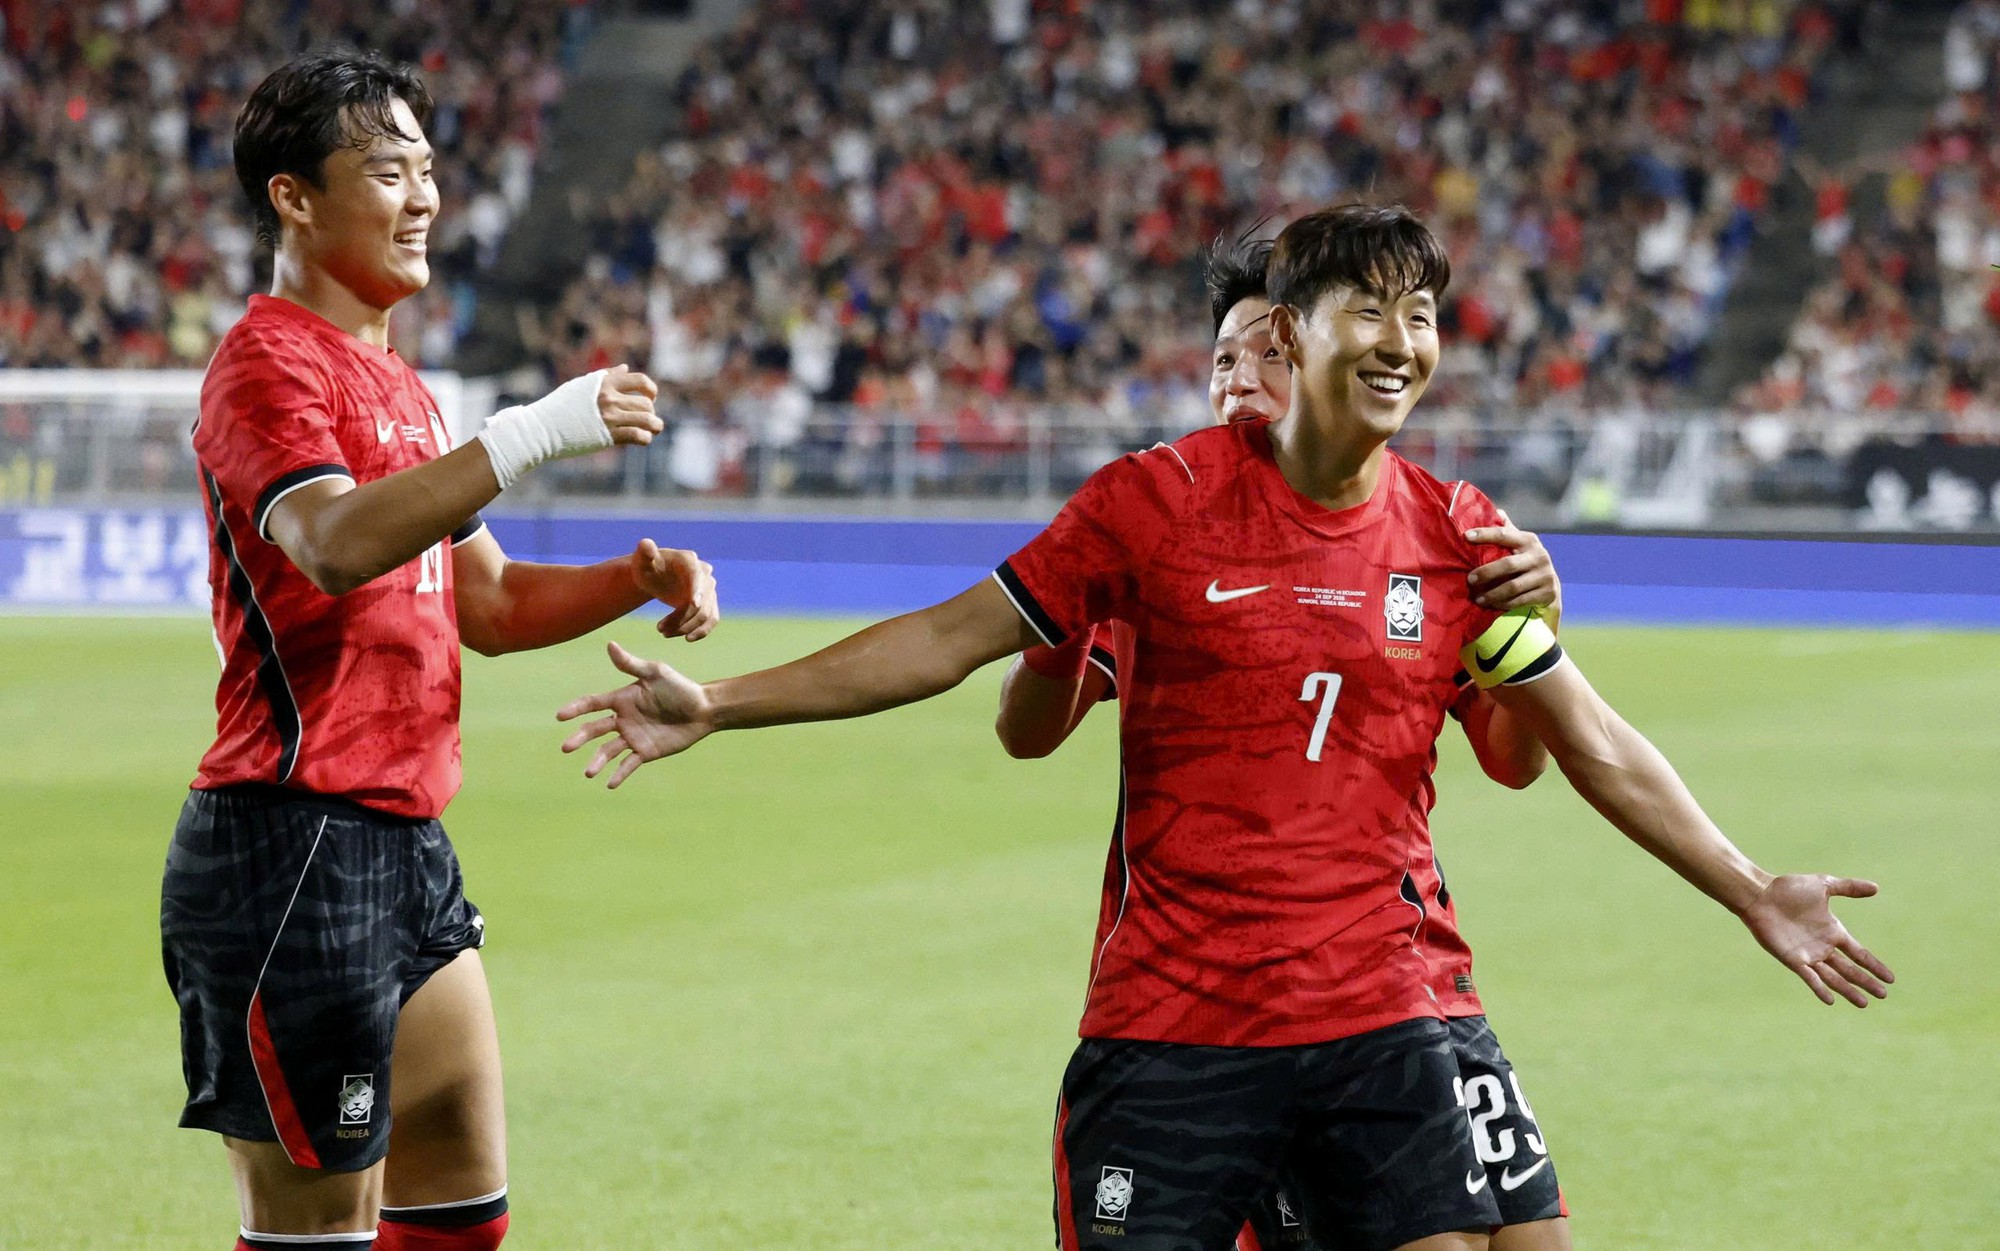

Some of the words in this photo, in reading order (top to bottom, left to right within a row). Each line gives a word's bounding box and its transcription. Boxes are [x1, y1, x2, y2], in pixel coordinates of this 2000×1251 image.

[1384, 646, 1421, 660] KOREA
[1297, 671, 1342, 762] 7
[336, 1128, 370, 1139] KOREA
[1091, 1223, 1126, 1236] KOREA
